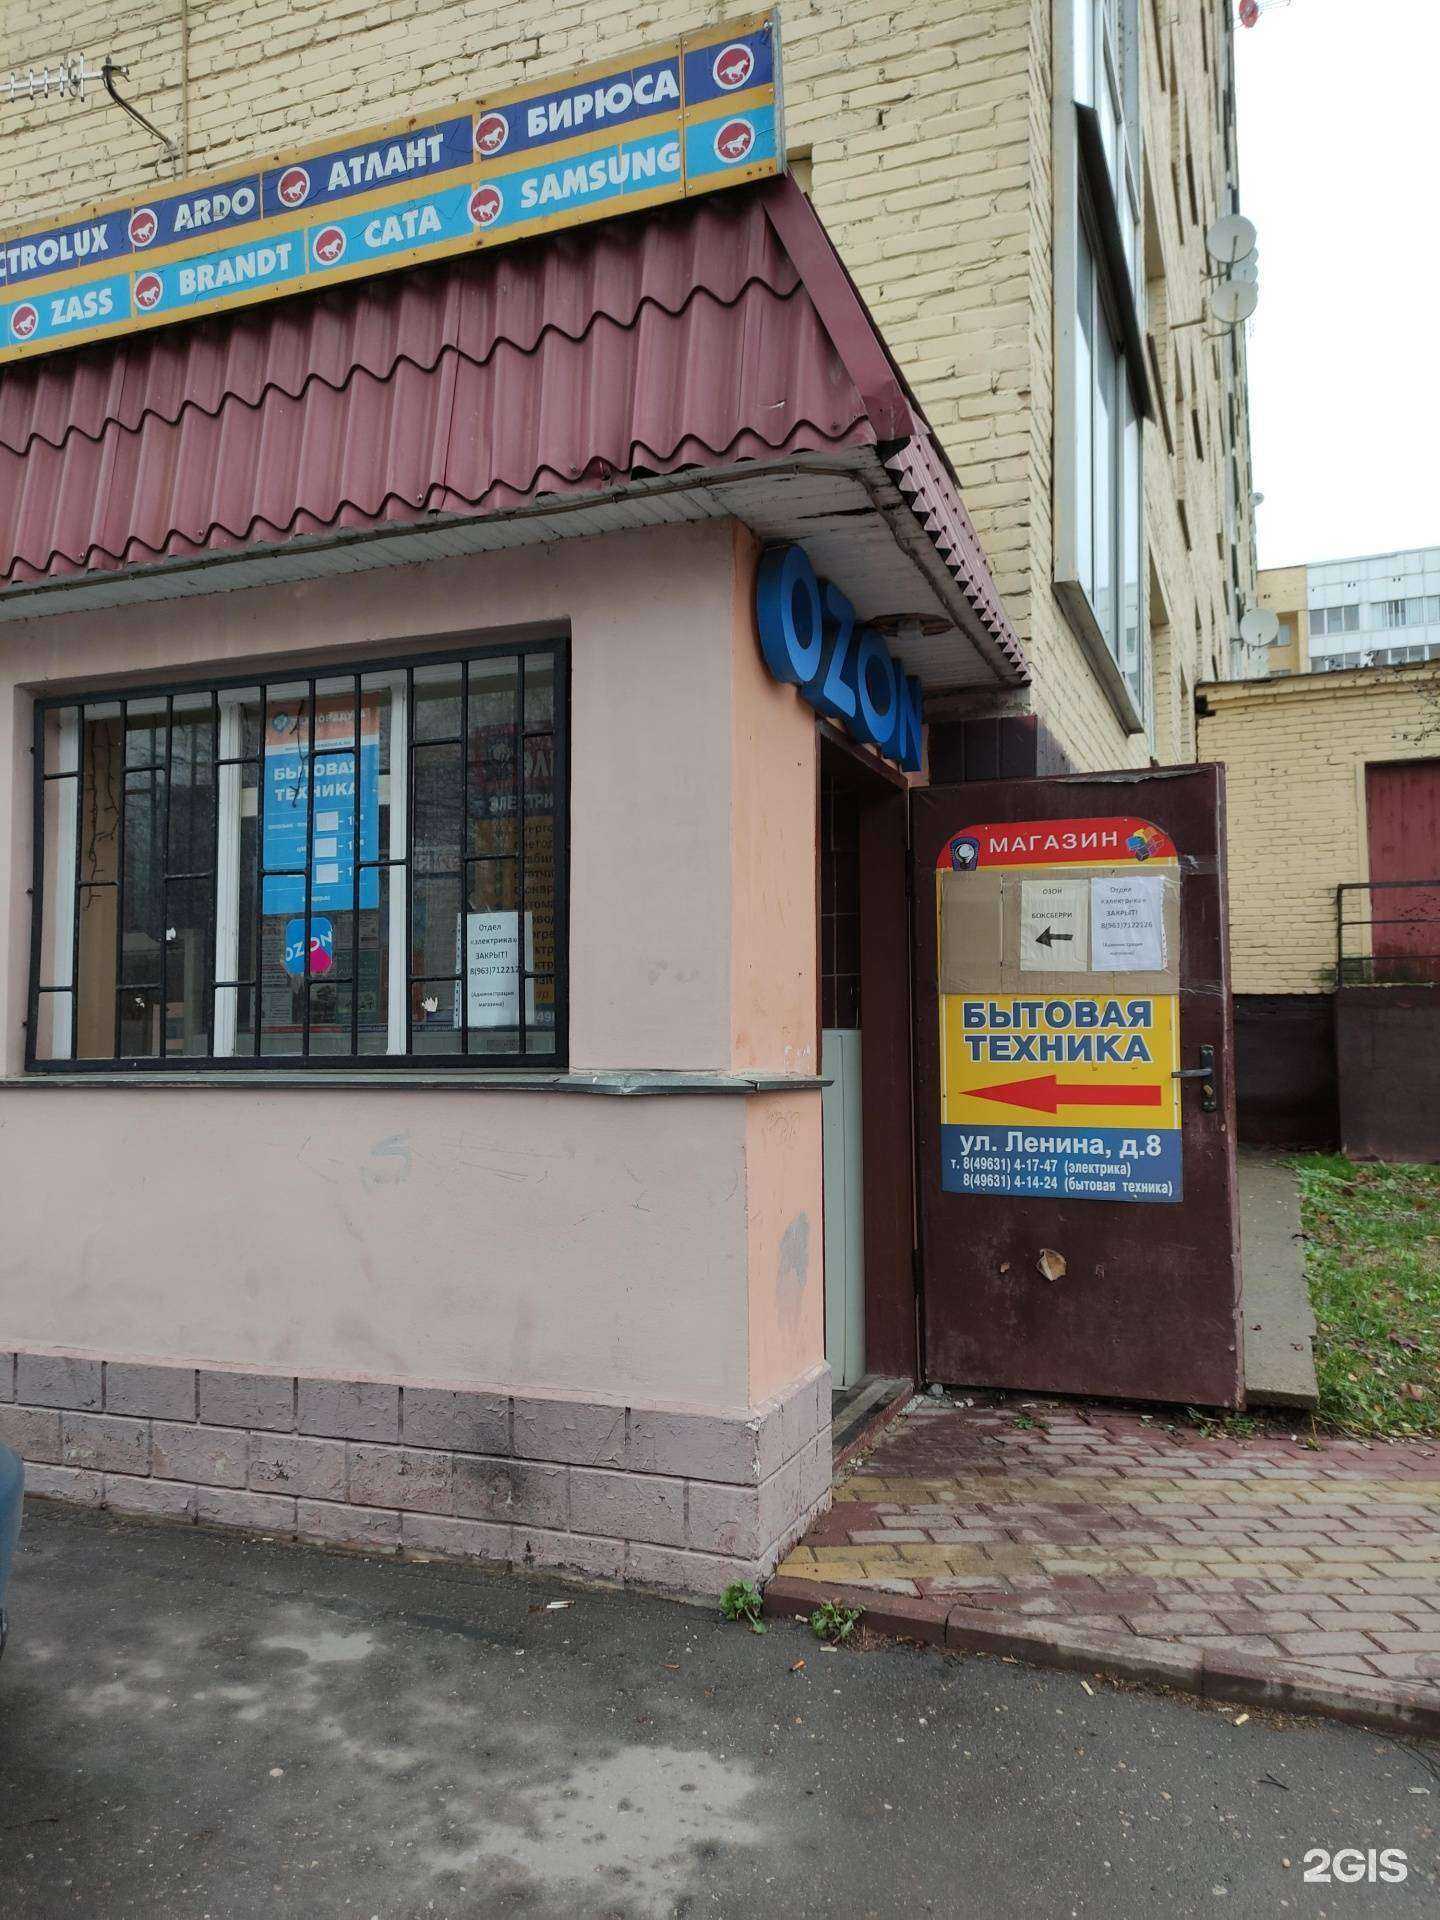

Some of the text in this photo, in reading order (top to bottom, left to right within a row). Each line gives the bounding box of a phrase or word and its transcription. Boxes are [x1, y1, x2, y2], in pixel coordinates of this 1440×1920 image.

[527, 69, 680, 138] БИРЮСА
[327, 133, 444, 192] АТЛАНТ
[520, 142, 681, 209] SAMSUNG
[173, 187, 256, 233] ARDO
[178, 243, 292, 296] BRANDT
[50, 288, 114, 327] ZASS
[757, 541, 922, 772] OZON
[989, 831, 1118, 853] МАГАЗИН
[478, 924, 502, 932] Отдел
[286, 928, 333, 962] OZON
[475, 951, 509, 960] ЗАКРЫТ!
[963, 1000, 1153, 1029] БЫТОВАЯ
[964, 1034, 1153, 1063] ТЕХНИКА
[960, 1131, 1162, 1160] ул. Ленина, д.8
[963, 1156, 1011, 1173] 8(49631)
[1014, 1158, 1058, 1171] 4-17-47
[1064, 1160, 1131, 1178] (электрика)
[963, 1173, 1173, 1196] 8(49631) 4-14-24 (бытовая техника)
